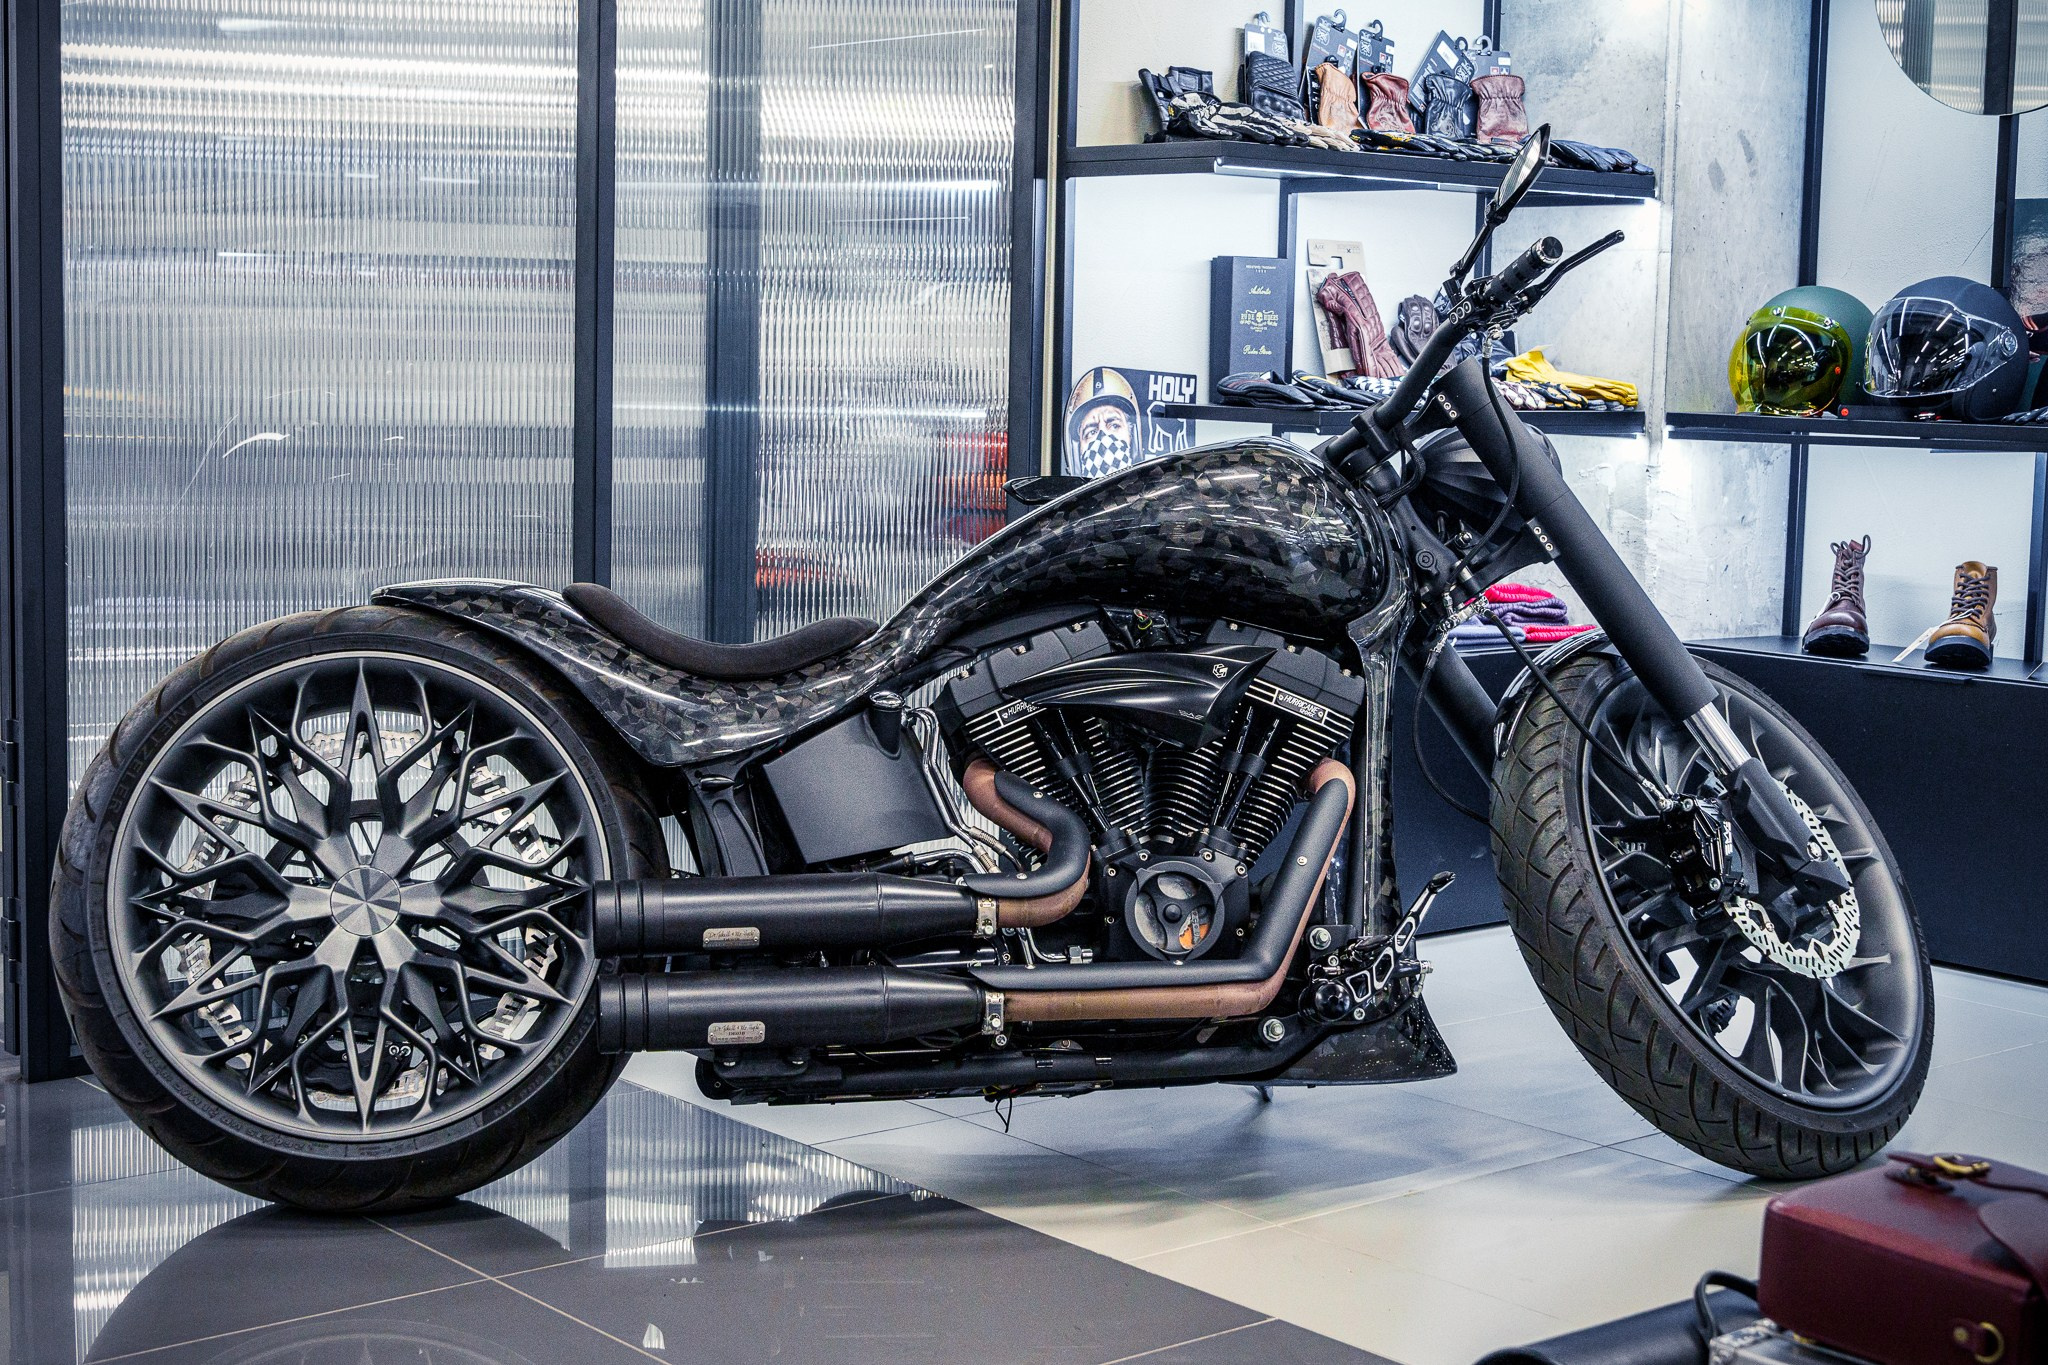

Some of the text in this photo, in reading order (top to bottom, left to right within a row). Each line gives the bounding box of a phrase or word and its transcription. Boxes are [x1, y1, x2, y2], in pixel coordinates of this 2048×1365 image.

[1148, 374, 1196, 403] HOLY
[1284, 695, 1320, 715] HURRICANE
[107, 705, 188, 813] METZELER
